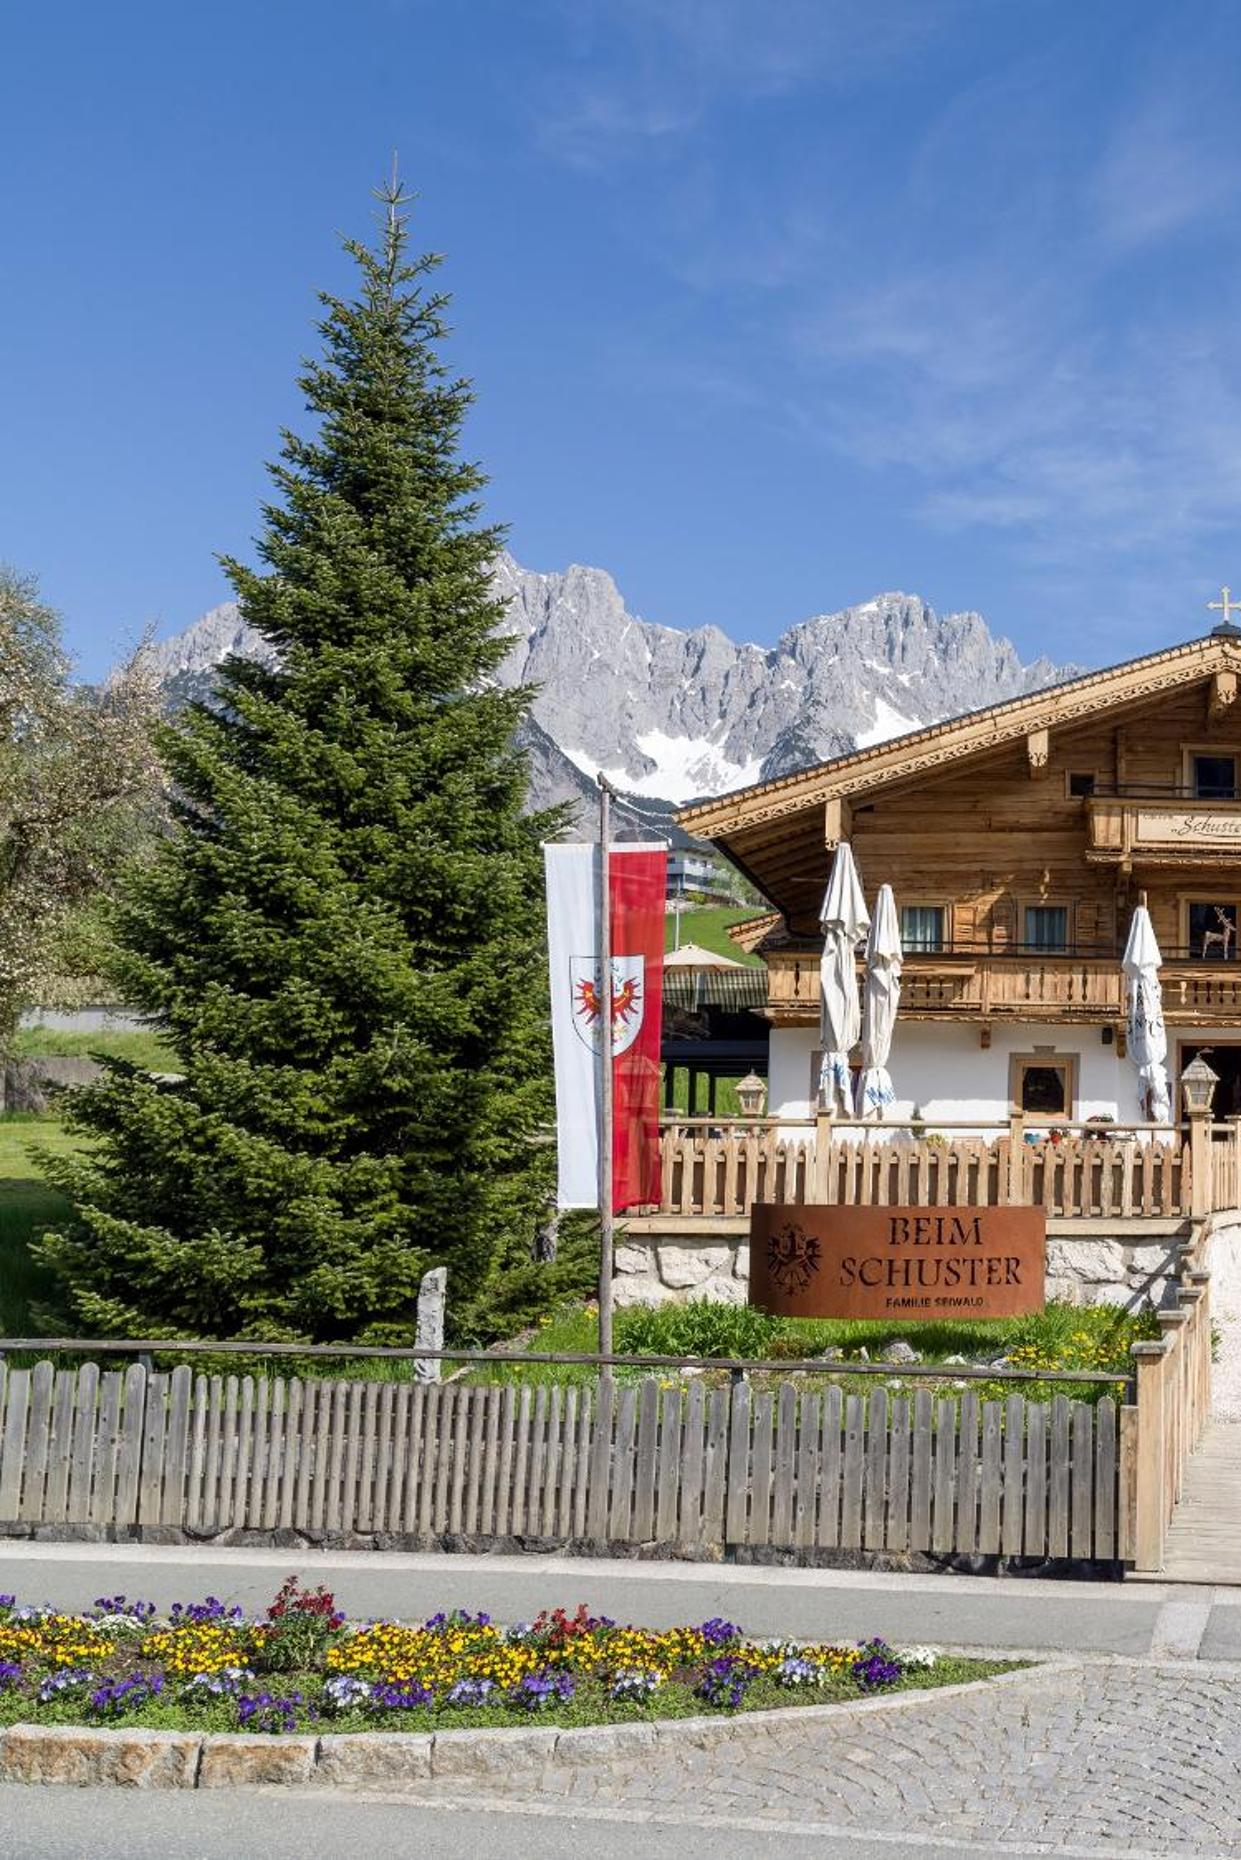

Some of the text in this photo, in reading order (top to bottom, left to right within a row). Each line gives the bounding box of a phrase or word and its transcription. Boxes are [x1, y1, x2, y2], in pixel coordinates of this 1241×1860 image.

[888, 1217, 982, 1245] BEIM
[839, 1257, 1022, 1287] SCHUSTER
[886, 1297, 932, 1308] FAMILIE
